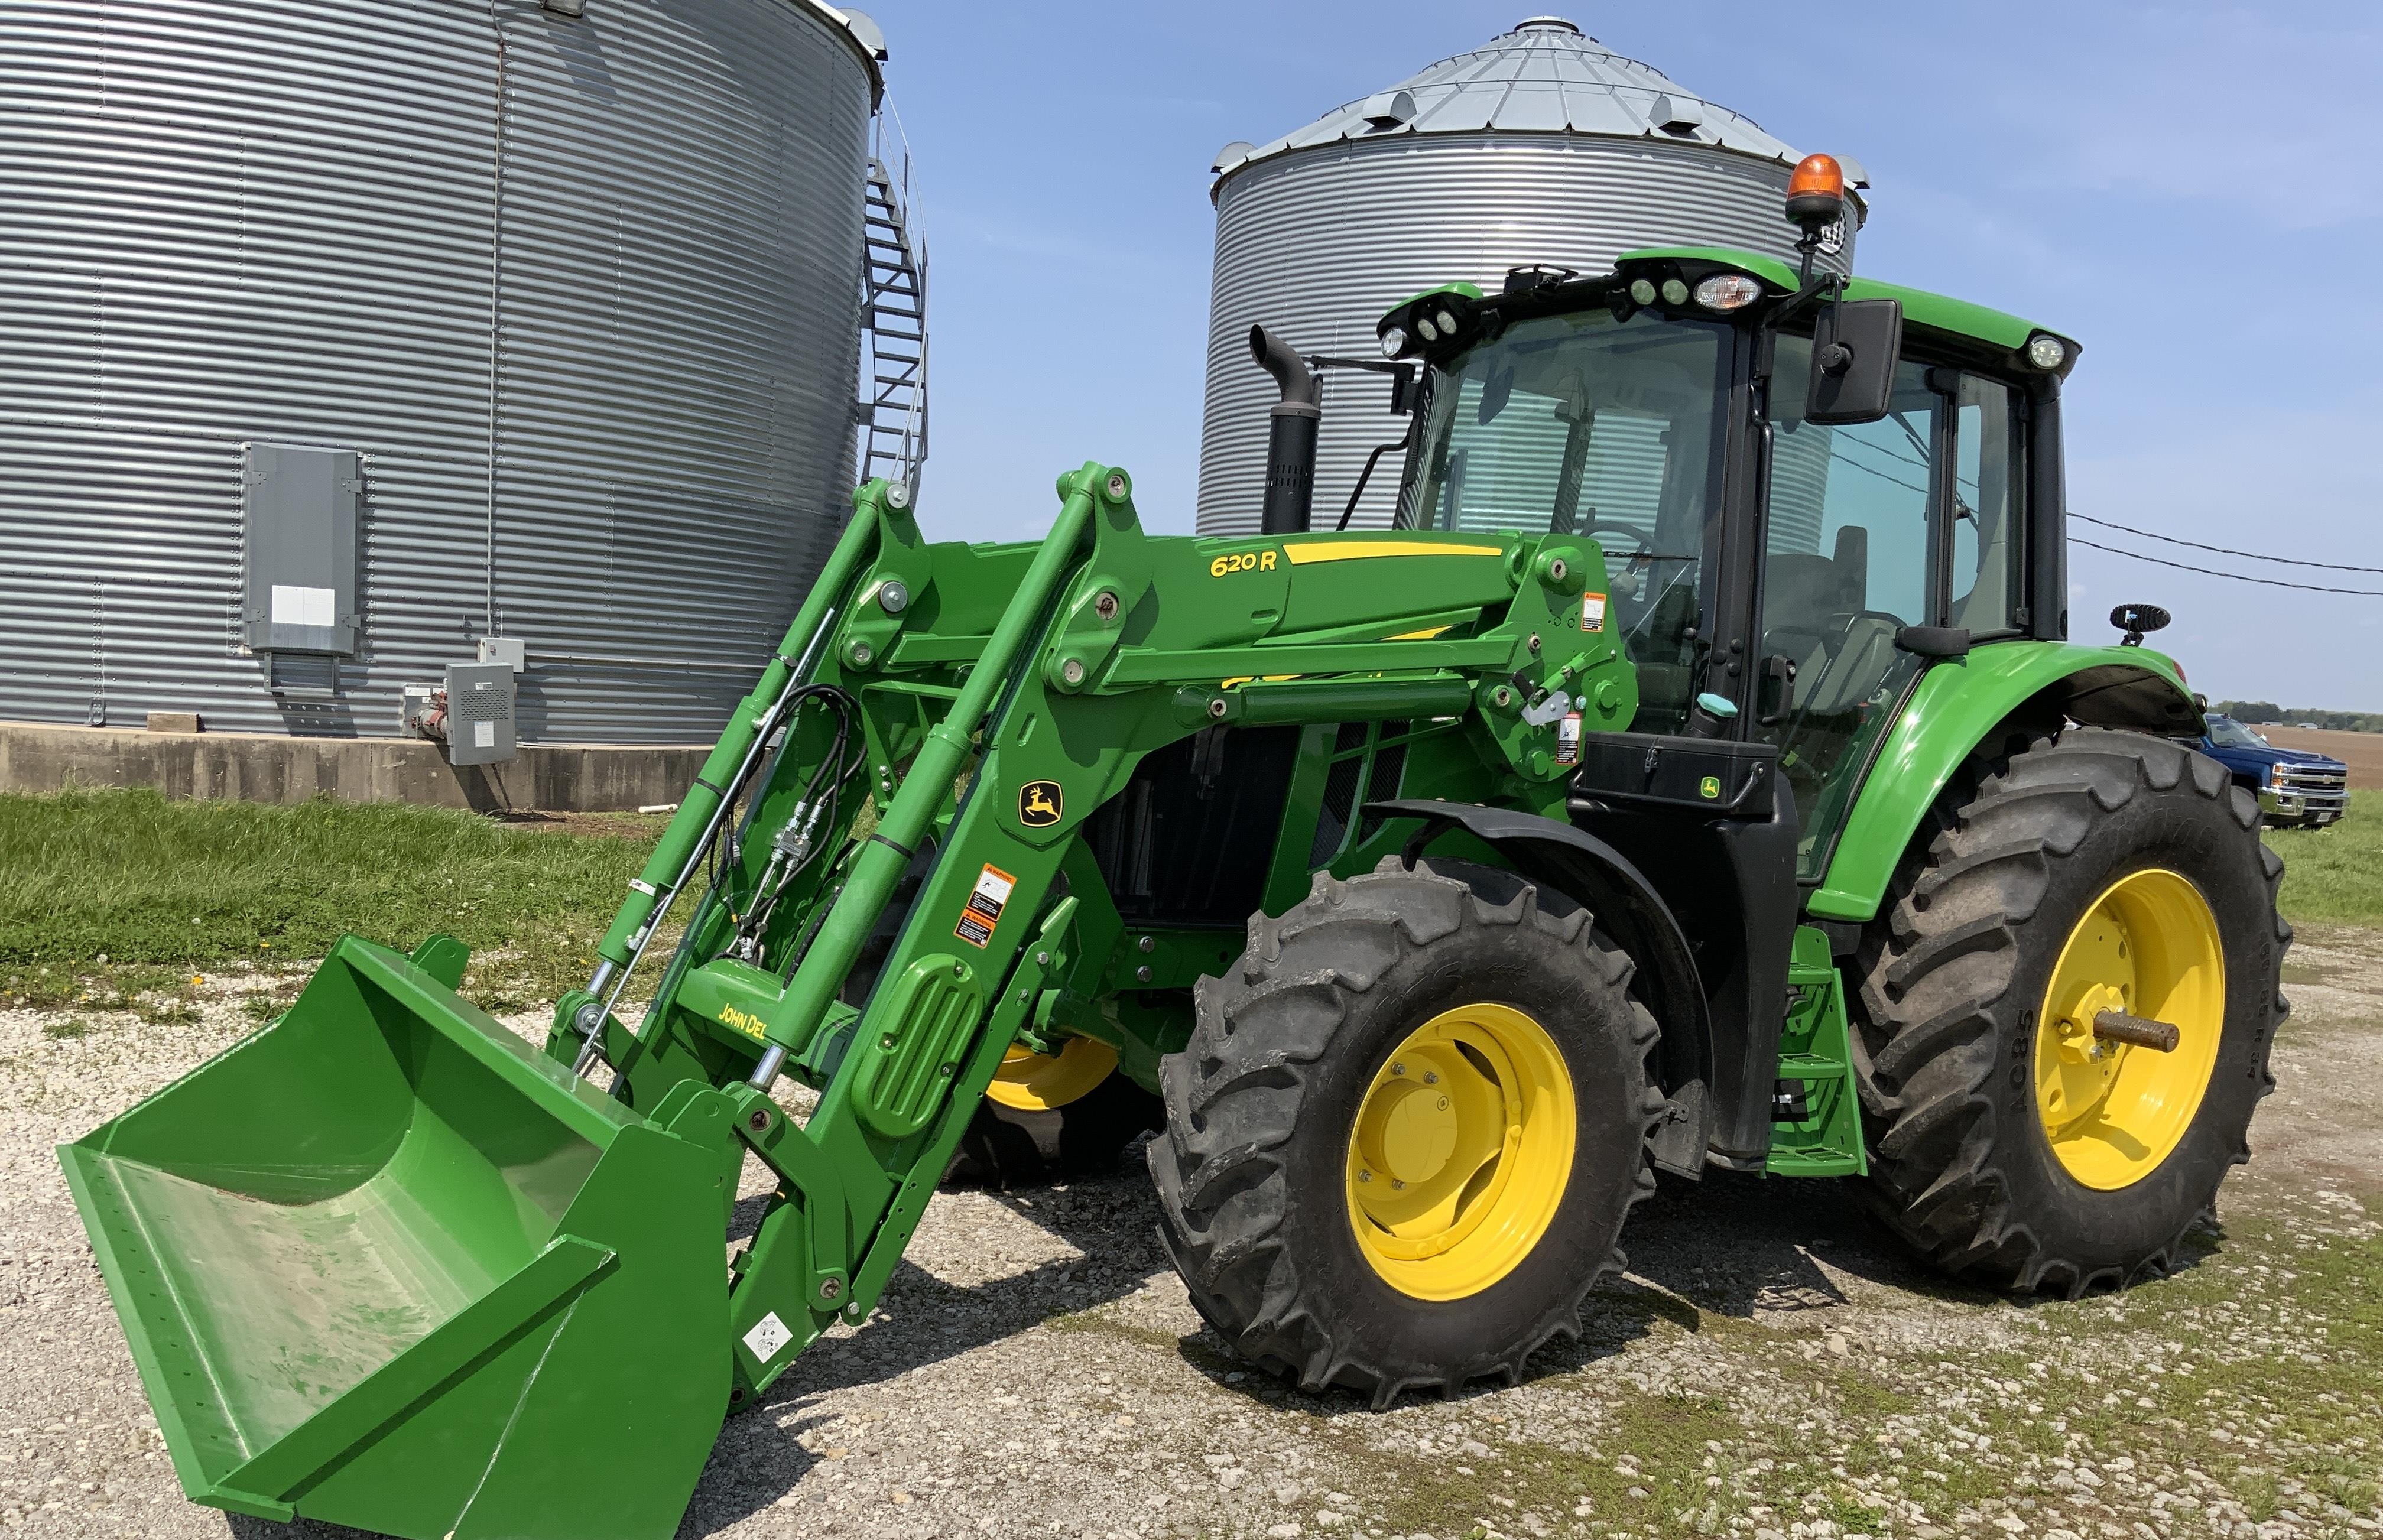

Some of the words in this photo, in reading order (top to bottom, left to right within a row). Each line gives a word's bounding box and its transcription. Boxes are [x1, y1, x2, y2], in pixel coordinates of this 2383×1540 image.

[1210, 553, 1257, 577] 620
[1259, 551, 1277, 572] R
[718, 1002, 748, 1030] JOHN
